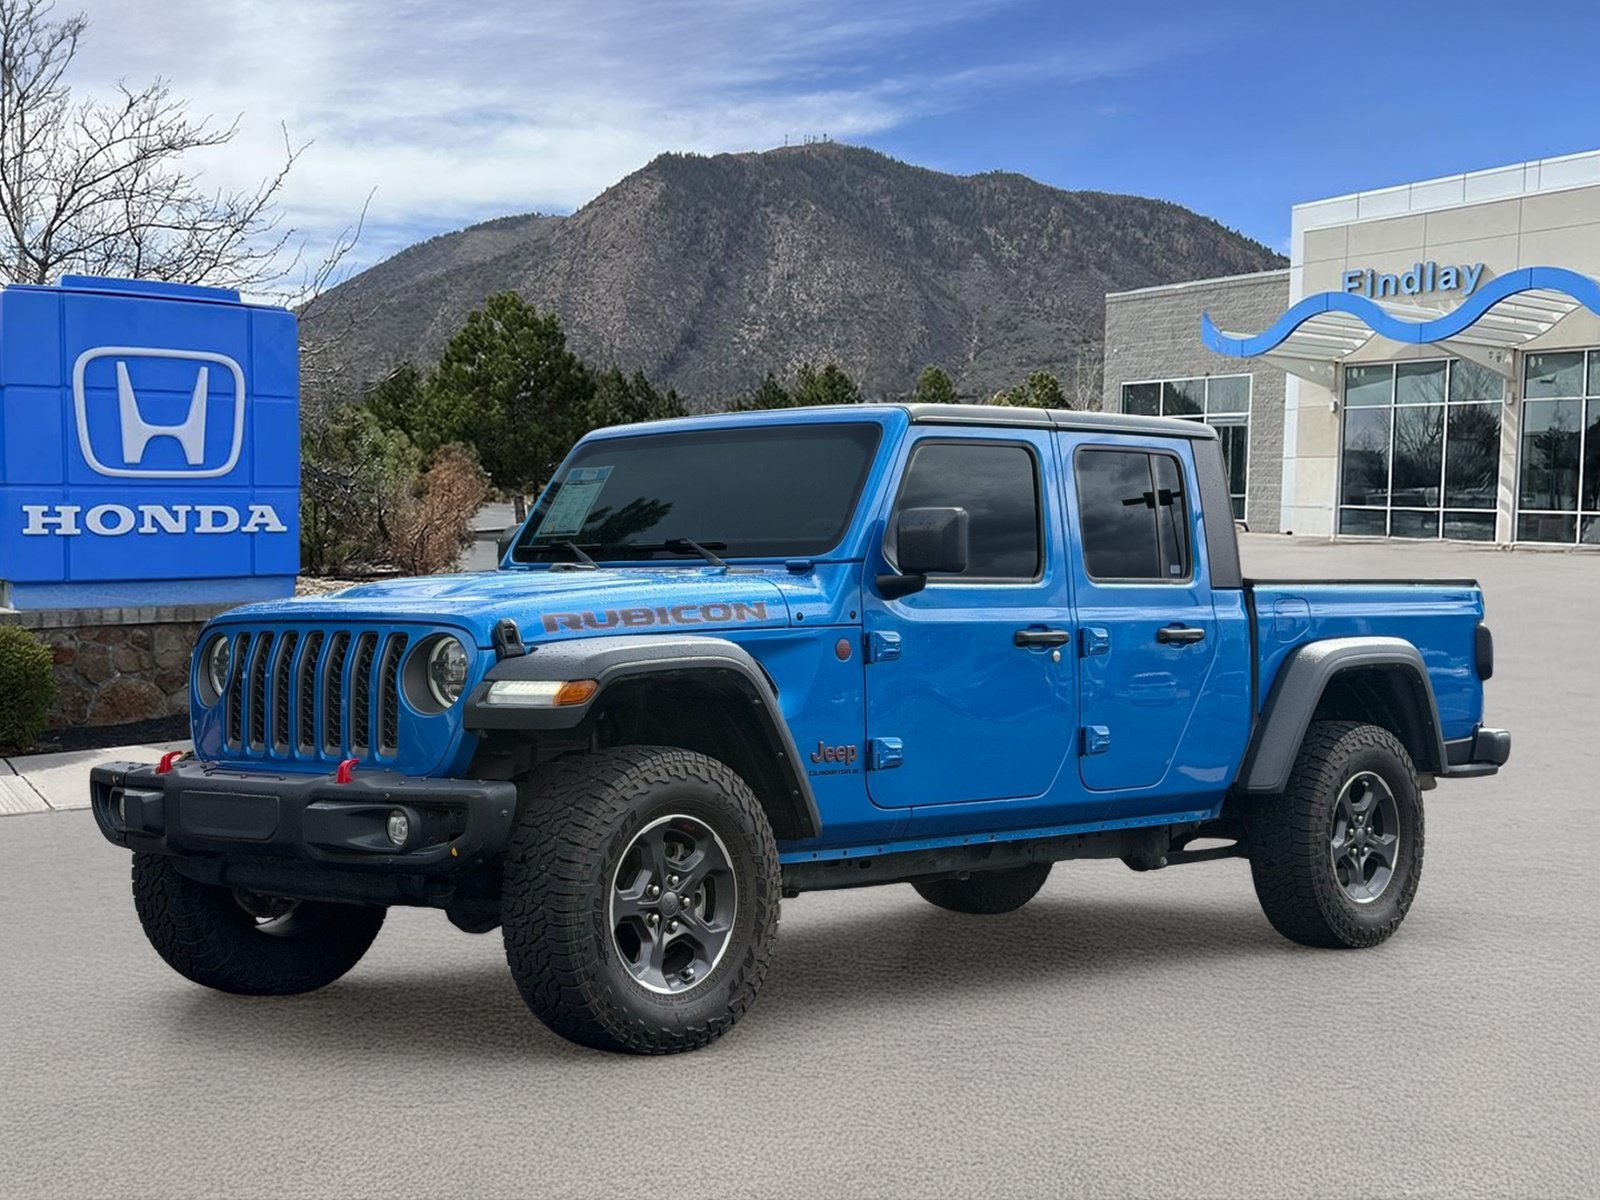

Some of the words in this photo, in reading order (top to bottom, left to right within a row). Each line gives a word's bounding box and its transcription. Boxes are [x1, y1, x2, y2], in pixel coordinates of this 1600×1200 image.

[22, 504, 288, 536] HONDA
[540, 602, 768, 635] RUBICON
[811, 741, 858, 765] Jeep
